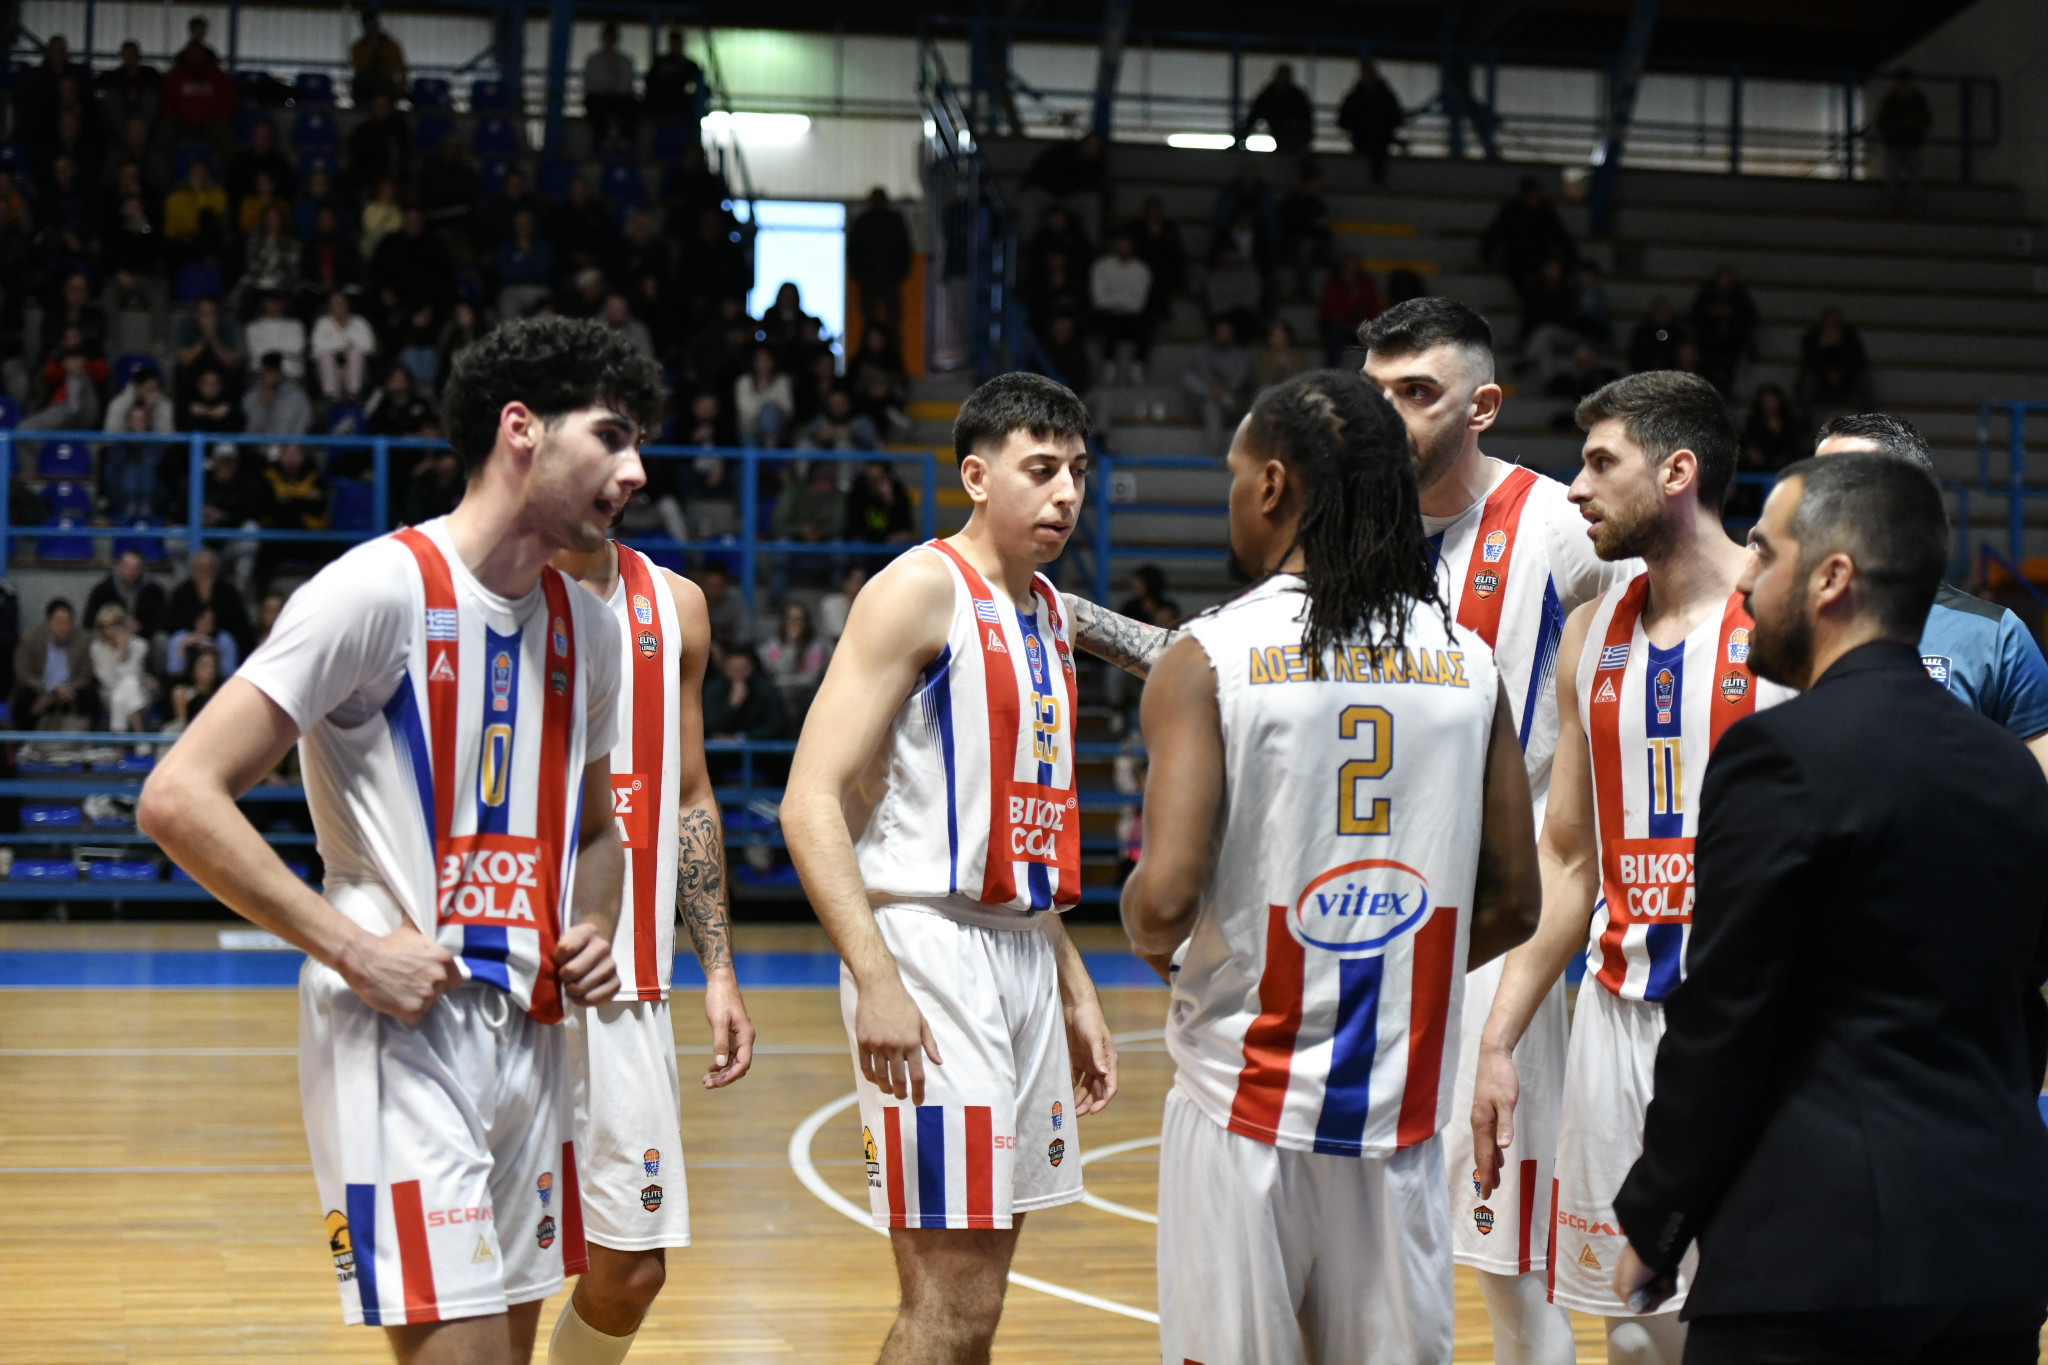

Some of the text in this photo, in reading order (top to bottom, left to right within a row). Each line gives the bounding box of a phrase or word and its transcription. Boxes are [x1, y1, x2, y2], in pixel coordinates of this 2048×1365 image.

[1474, 575, 1498, 585] ELITE
[639, 636, 658, 645] ELITE
[1722, 678, 1747, 688] ELITE
[1031, 691, 1061, 764] 22
[480, 724, 512, 807] 0
[1337, 704, 1393, 836] 2
[1647, 737, 1684, 815] 11
[1316, 883, 1409, 917] vitex
[642, 1190, 662, 1199] ELITE
[1475, 1212, 1494, 1221] ELITE
